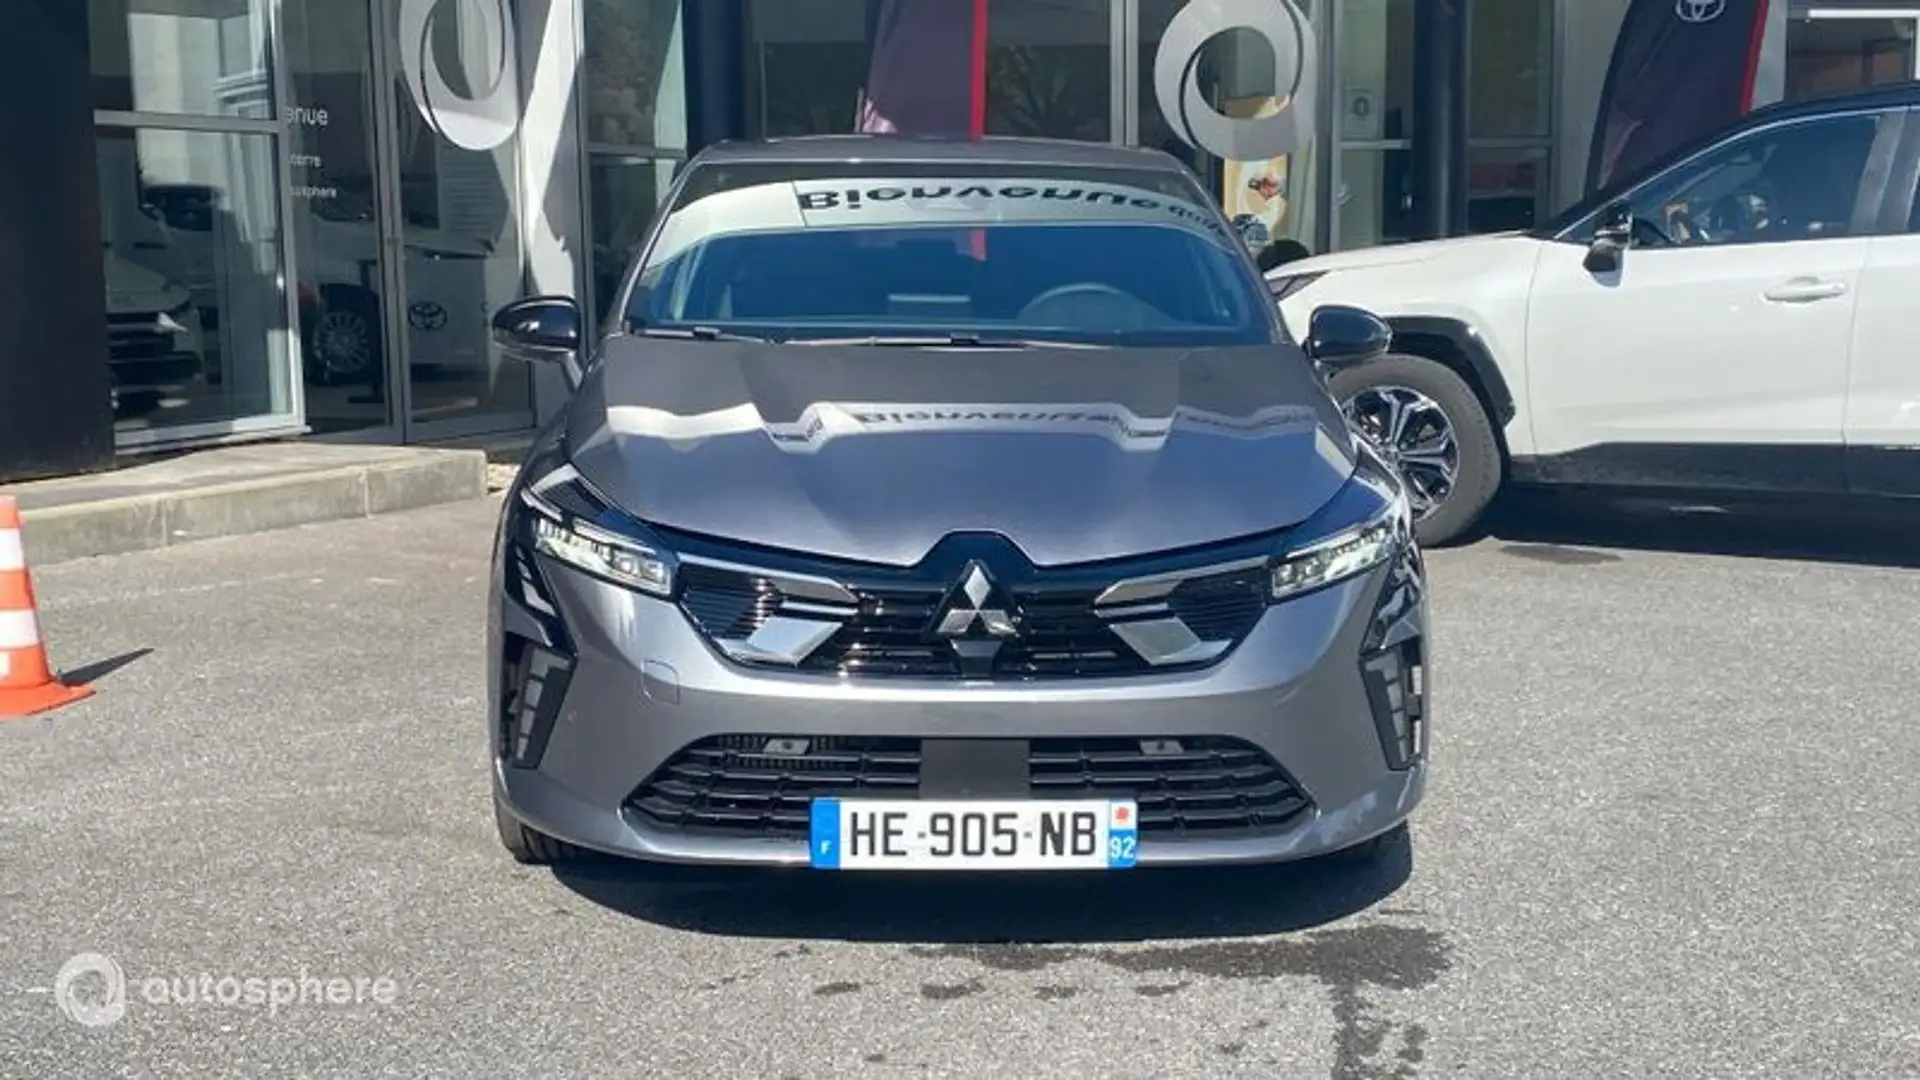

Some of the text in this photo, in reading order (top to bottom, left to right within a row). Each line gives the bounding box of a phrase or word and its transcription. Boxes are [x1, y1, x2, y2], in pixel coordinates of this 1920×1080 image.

[850, 811, 1097, 857] HE-905-NB
[820, 841, 831, 854] F
[1109, 836, 1136, 861] 92
